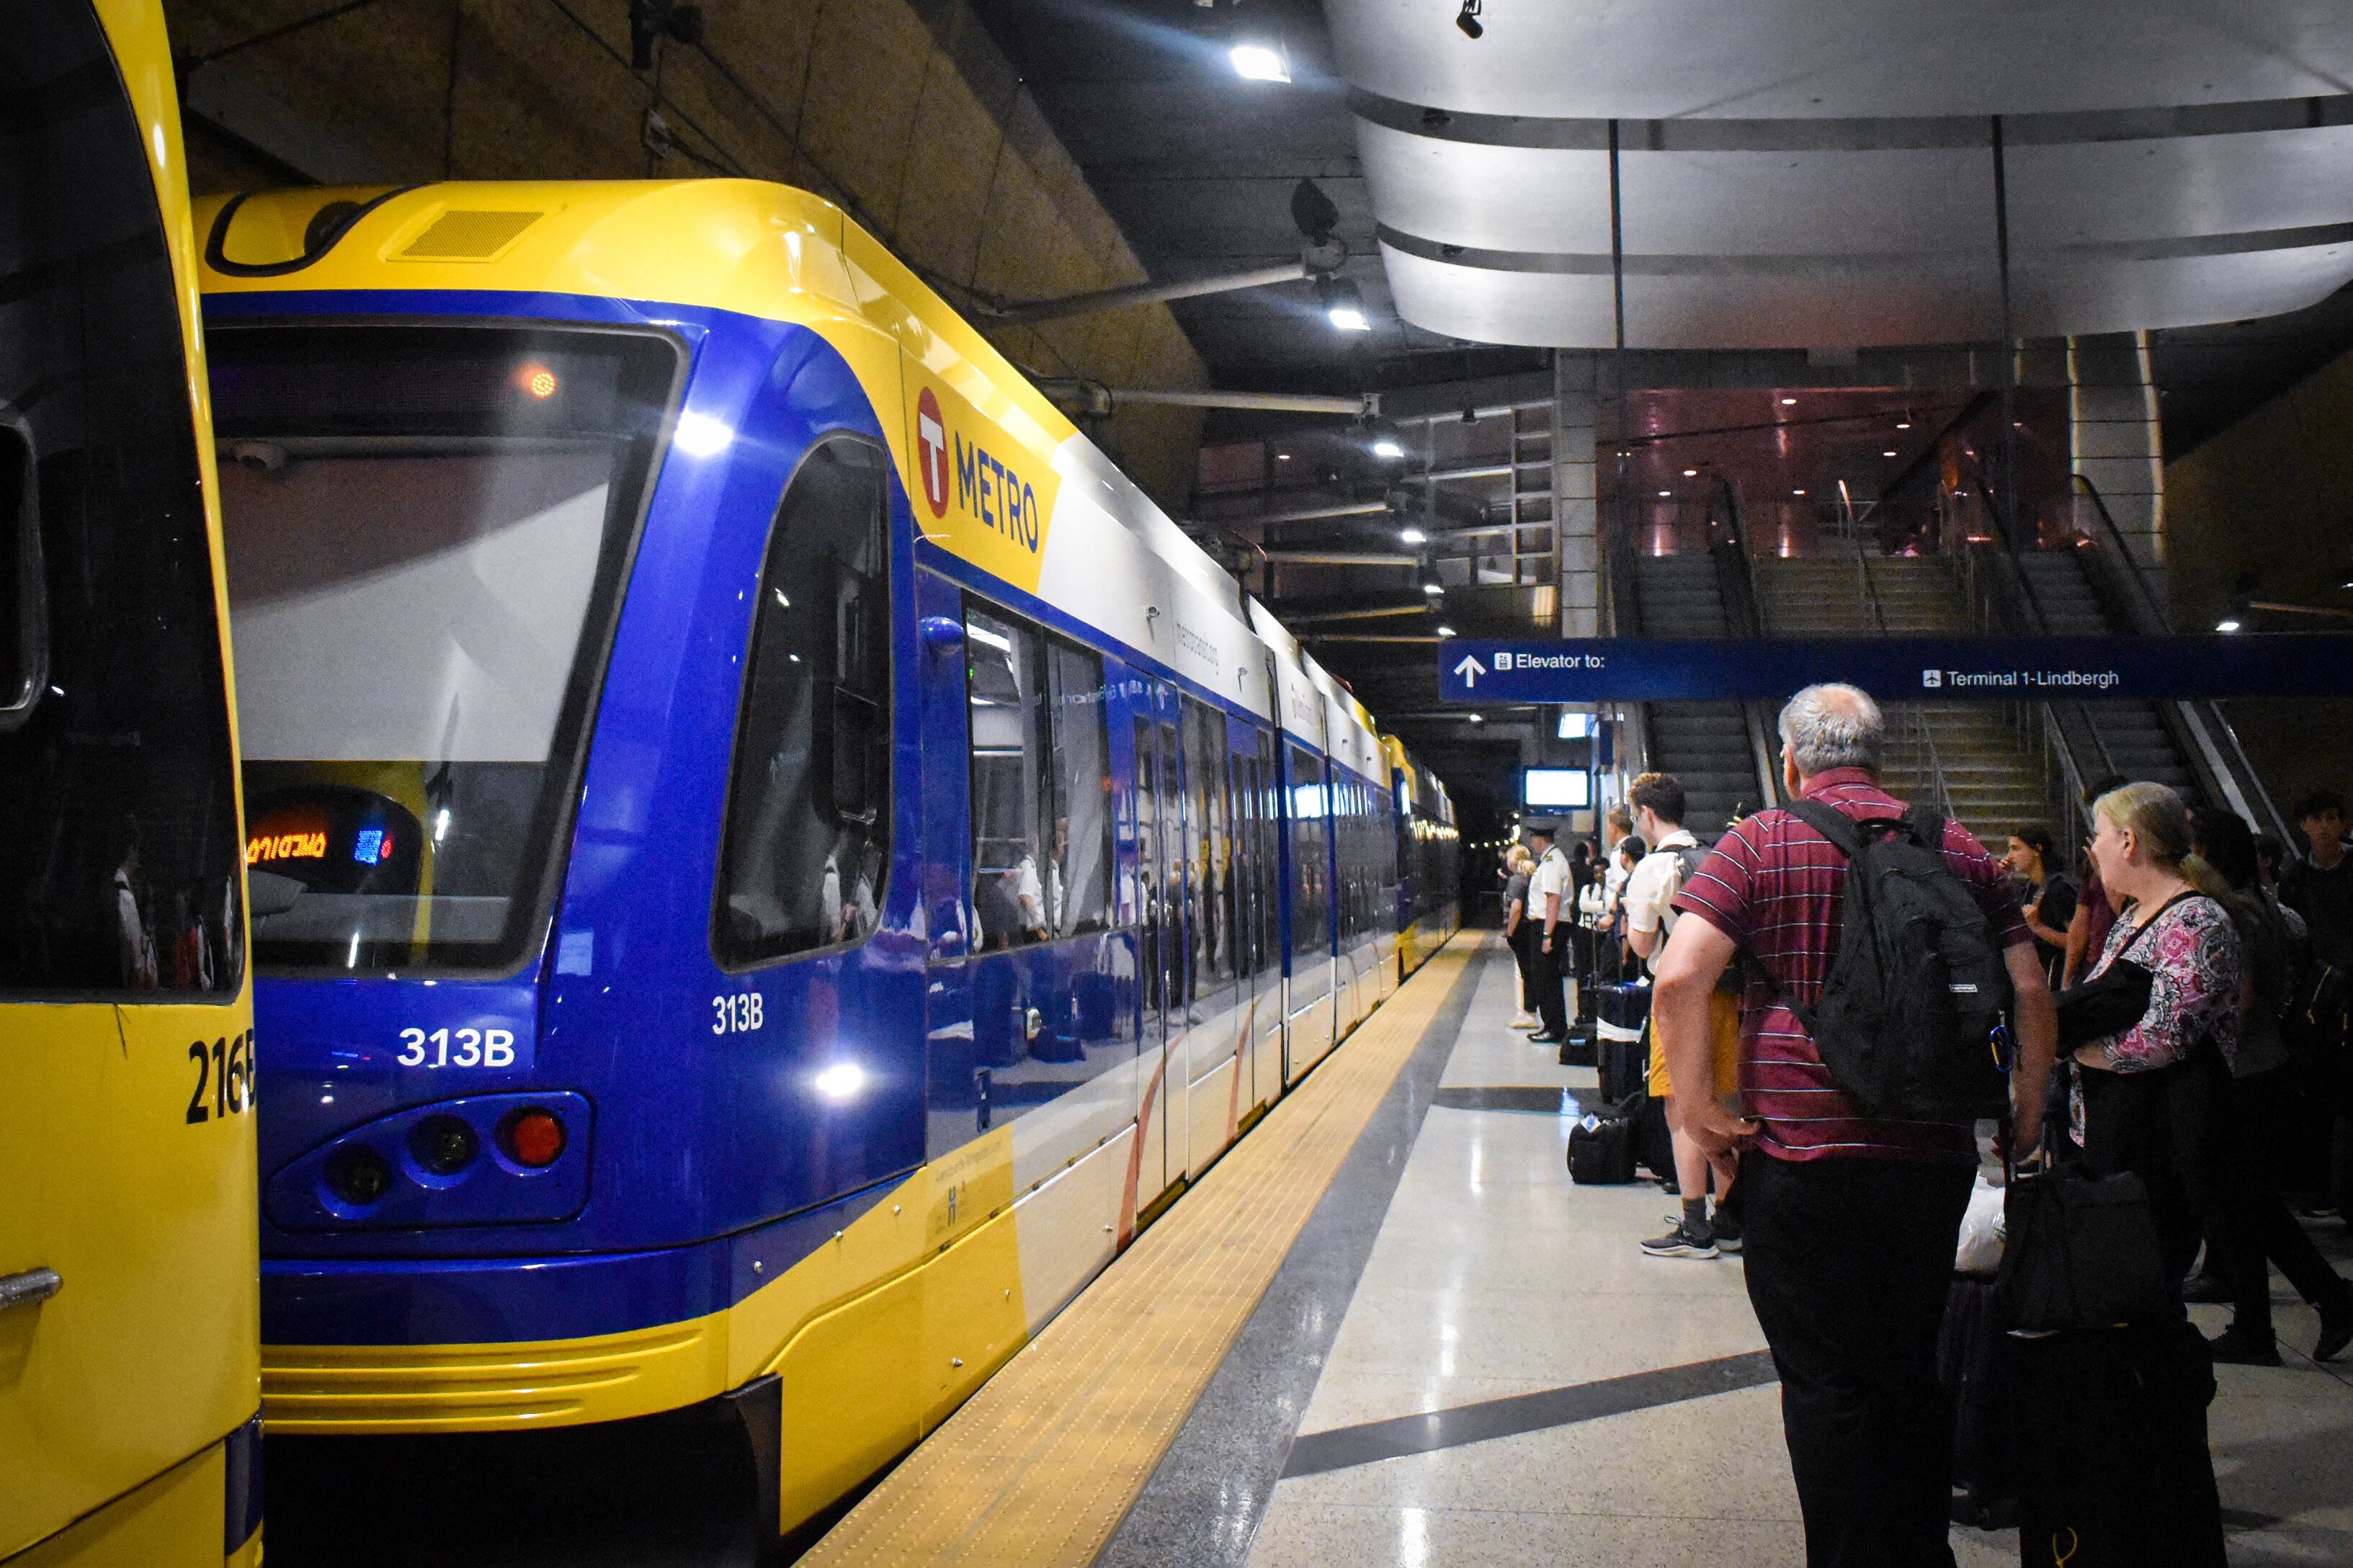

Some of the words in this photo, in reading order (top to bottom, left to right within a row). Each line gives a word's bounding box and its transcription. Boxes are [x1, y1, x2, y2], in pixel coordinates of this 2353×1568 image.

[955, 430, 1038, 554] METRO
[1517, 653, 1581, 668] Elevator
[1585, 654, 1605, 668] to:
[1946, 671, 2017, 685] Terminal
[2022, 671, 2119, 689] 1-Lindbergh
[712, 993, 763, 1036] 313B
[397, 1028, 515, 1067] 313B
